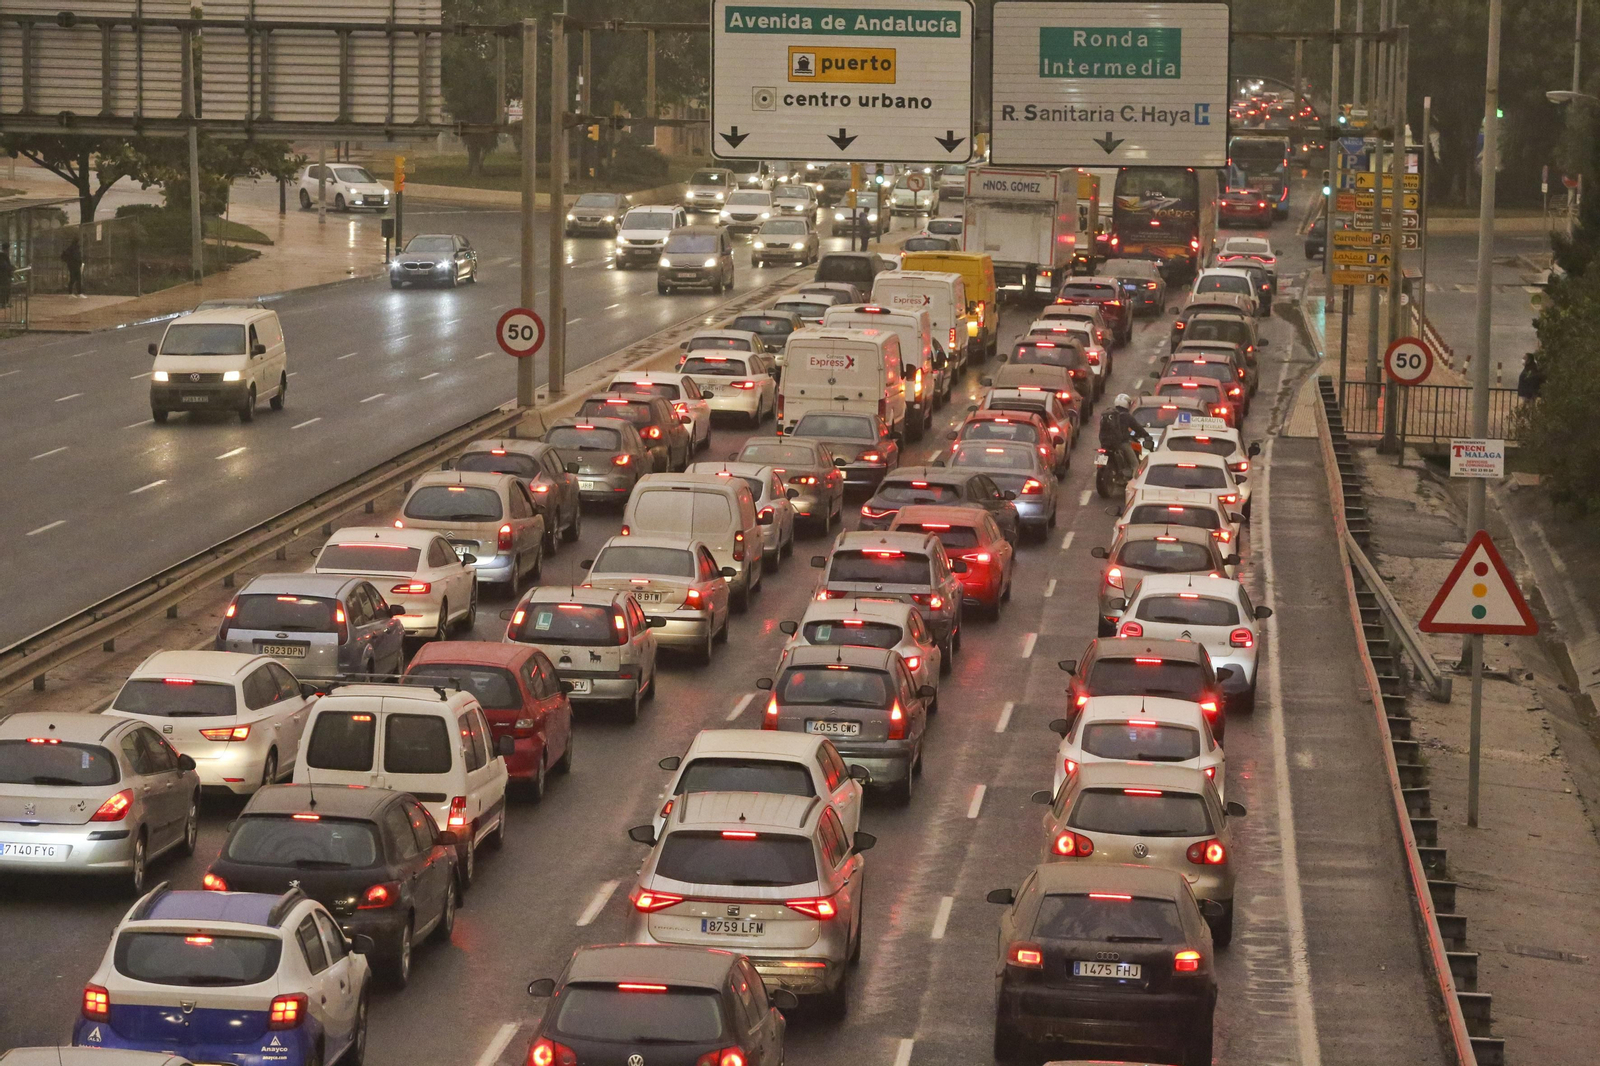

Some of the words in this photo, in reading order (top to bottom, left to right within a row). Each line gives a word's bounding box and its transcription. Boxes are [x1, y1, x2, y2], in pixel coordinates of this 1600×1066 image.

[728, 12, 813, 30] Avenida
[820, 14, 846, 31] de
[853, 14, 957, 33] Andalucía
[1073, 30, 1148, 47] Ronda
[821, 55, 892, 73] puerto
[1043, 58, 1176, 76] Intermedia
[783, 91, 851, 108] centro
[858, 93, 932, 109] urbano
[1002, 104, 1019, 121] R.
[1024, 104, 1115, 122] Sanitaria
[1141, 106, 1190, 126] Haya
[983, 180, 1009, 192] HNOS.
[1333, 233, 1372, 242] Carrefour
[893, 296, 922, 305] Express
[508, 324, 534, 341] 50
[810, 357, 845, 368] Express
[1396, 353, 1422, 369] 50
[1452, 445, 1486, 458] TECNI
[813, 723, 839, 732] 4055
[840, 724, 857, 734] CWC
[5, 844, 32, 856] 7140
[34, 846, 55, 857] FYG
[709, 920, 738, 933] 8759
[741, 922, 764, 934] LFM
[1083, 963, 1112, 976] 1475
[1115, 965, 1139, 977] FHJ
